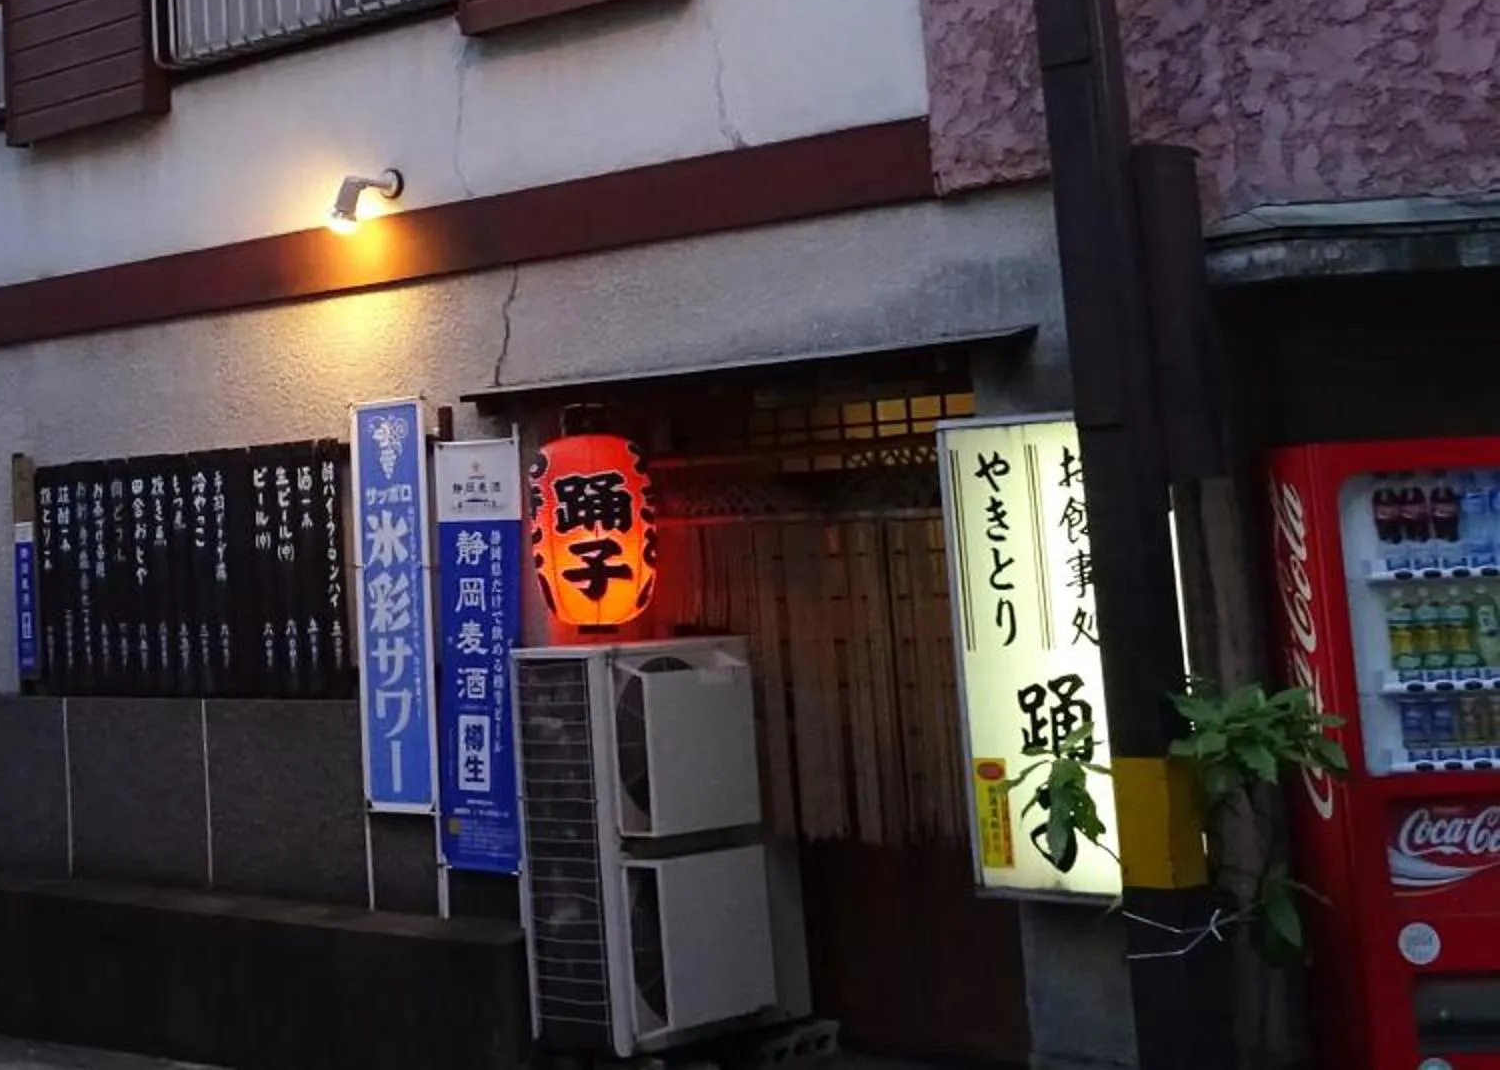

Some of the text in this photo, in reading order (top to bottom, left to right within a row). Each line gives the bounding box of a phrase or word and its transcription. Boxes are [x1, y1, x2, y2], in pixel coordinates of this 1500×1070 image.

[365, 484, 412, 505] サッポロ
[553, 471, 633, 601] 踊子
[974, 450, 1017, 647] やきとり
[1058, 445, 1100, 647] お食事処
[366, 509, 413, 794] 氷彩サワー
[455, 530, 490, 699] 静岡麦酒
[464, 723, 486, 784] 樽生
